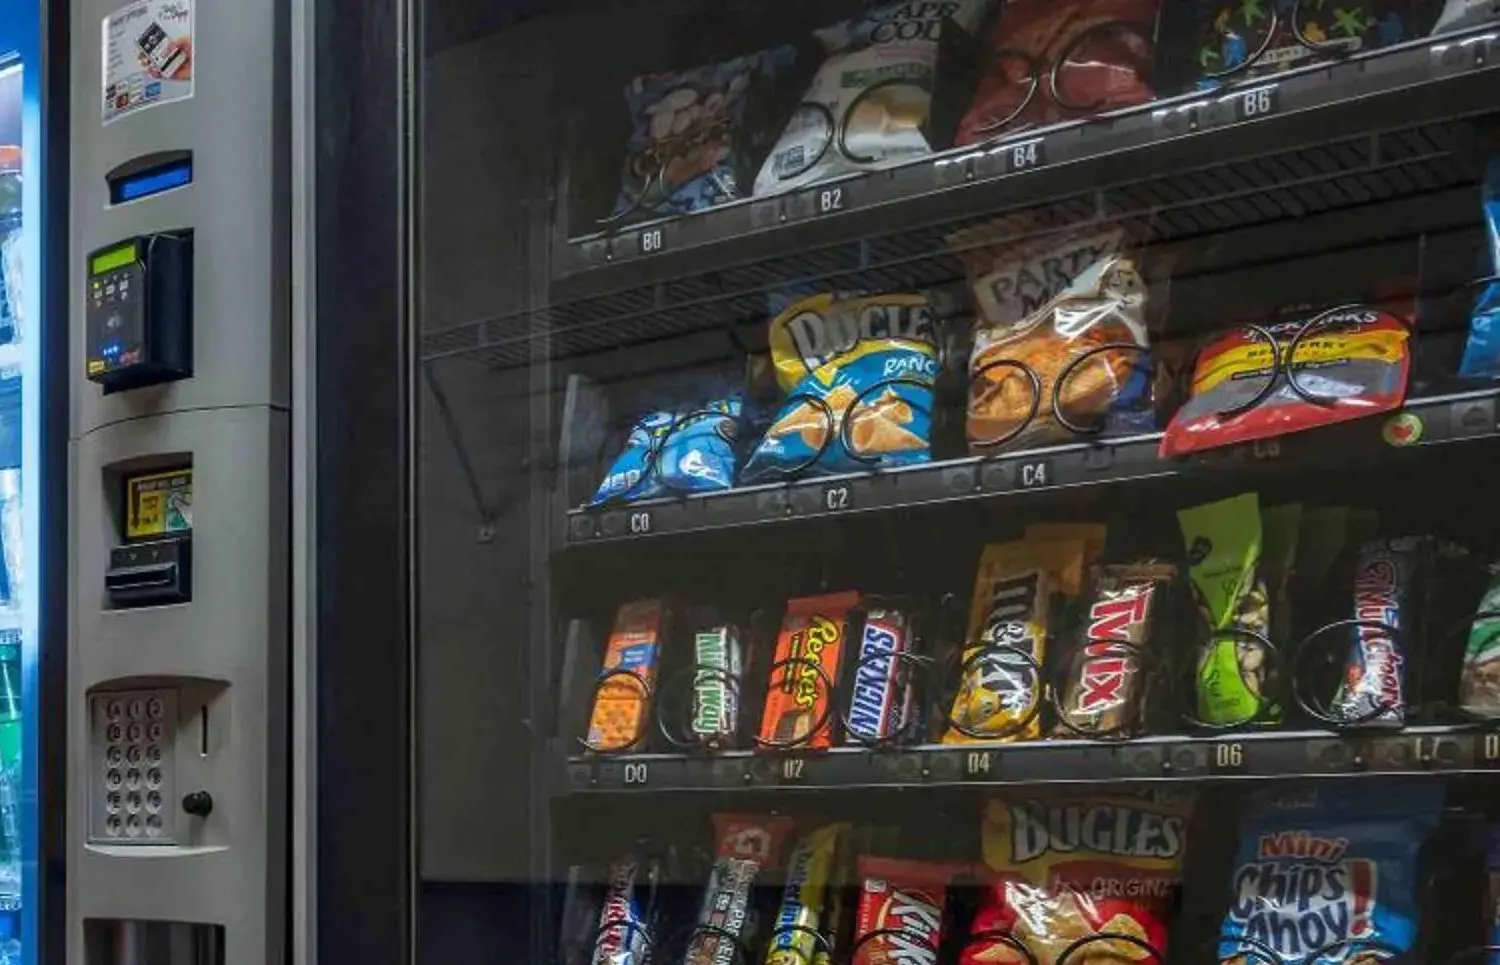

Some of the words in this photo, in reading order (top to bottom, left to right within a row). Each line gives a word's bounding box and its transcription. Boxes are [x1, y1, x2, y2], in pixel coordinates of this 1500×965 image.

[1245, 91, 1269, 114] B6
[1014, 144, 1038, 168] B4
[822, 188, 842, 211] B2
[884, 357, 936, 376] RANC
[1023, 464, 1045, 486] C4
[827, 488, 848, 509] C2
[850, 626, 896, 738] NICKERS
[1217, 743, 1243, 766] D6
[1011, 801, 1184, 863] BUGLES
